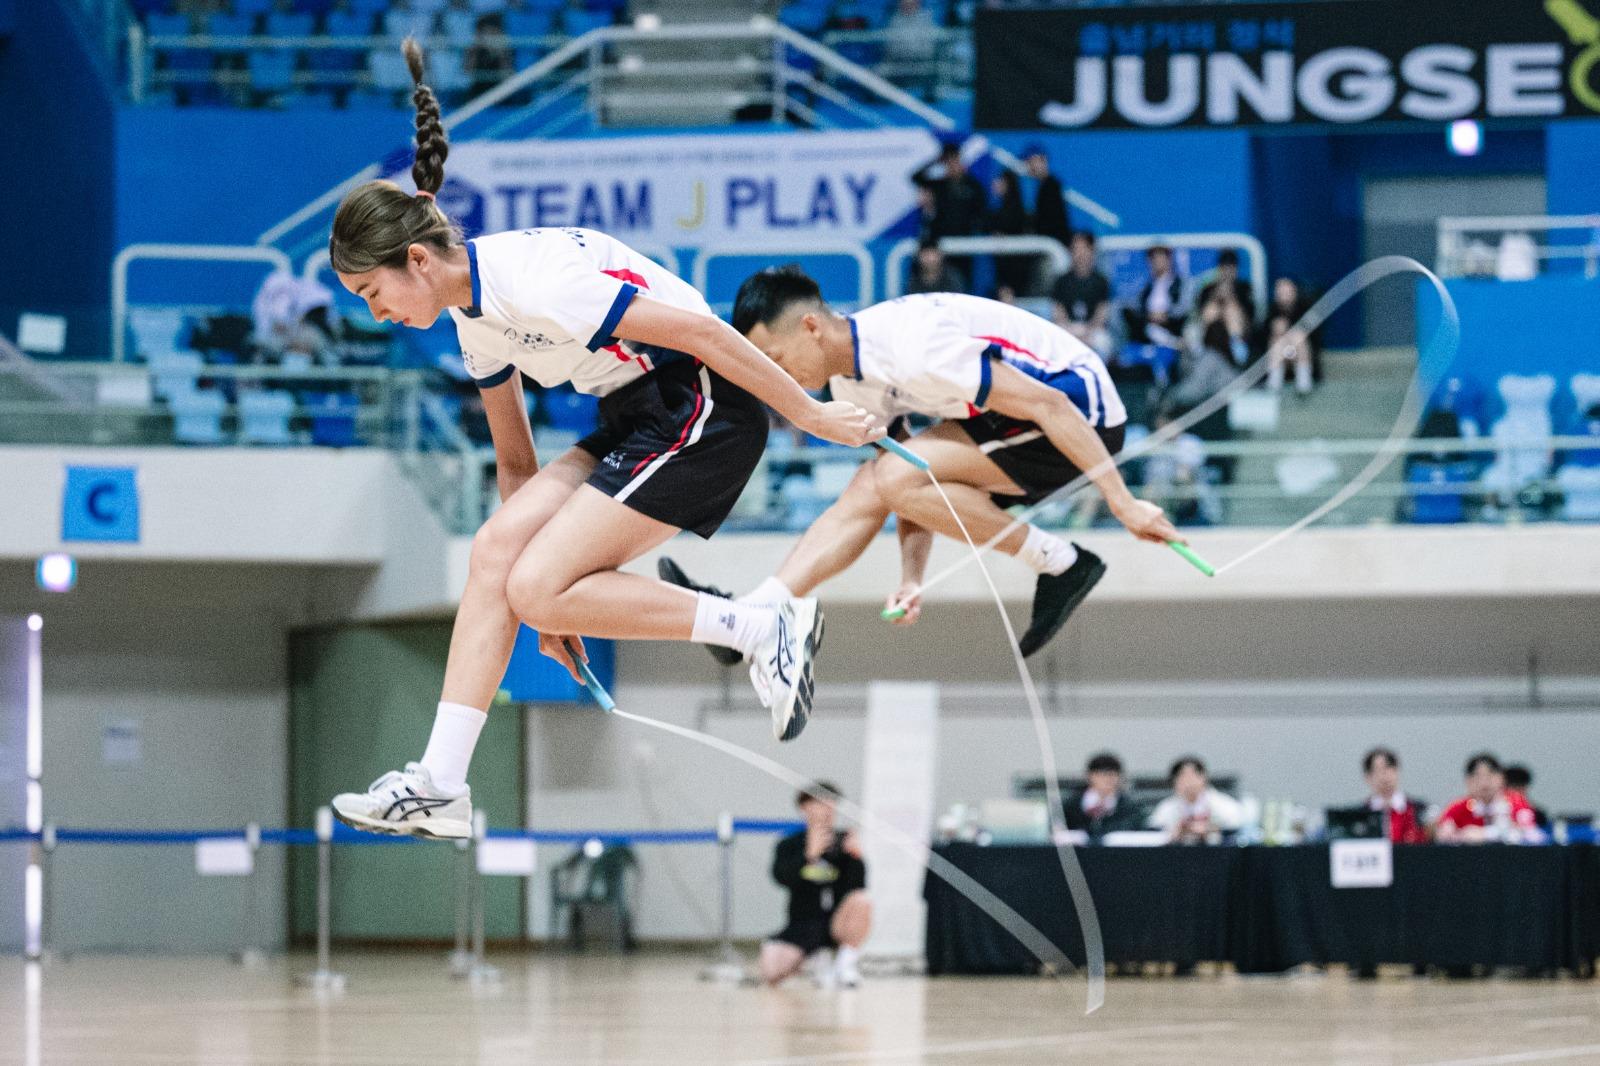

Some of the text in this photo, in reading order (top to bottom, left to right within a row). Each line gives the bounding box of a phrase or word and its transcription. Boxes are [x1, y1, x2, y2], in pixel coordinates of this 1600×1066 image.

[494, 174, 878, 231] TEAM J PLAY
[86, 482, 117, 525] C
